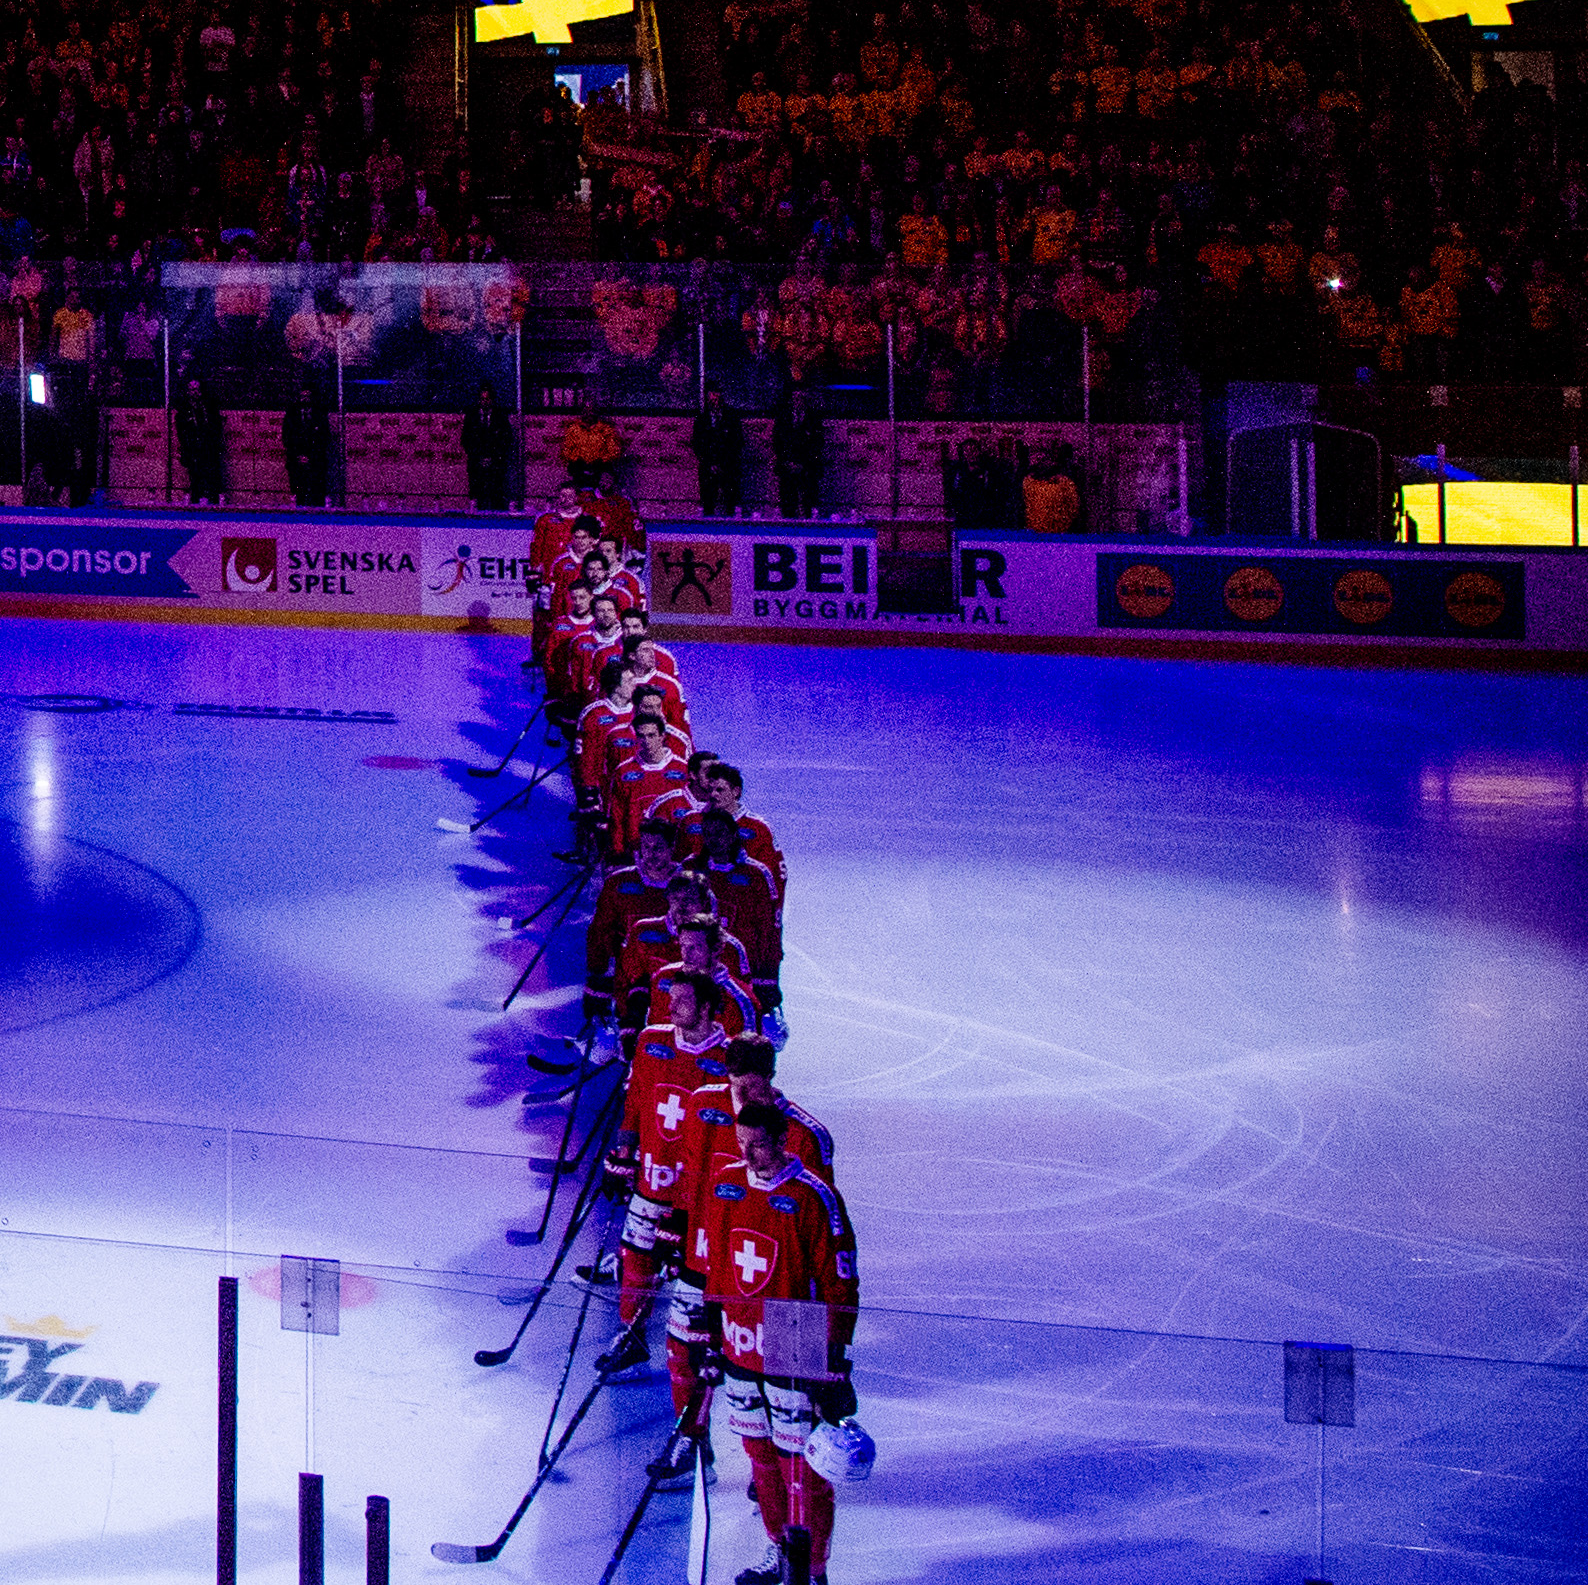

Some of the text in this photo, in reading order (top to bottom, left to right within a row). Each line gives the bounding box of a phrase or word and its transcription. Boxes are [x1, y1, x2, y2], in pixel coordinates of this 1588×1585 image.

[288, 550, 417, 573] SVENSKA
[753, 543, 1008, 598] BEIR
[288, 574, 355, 596] SPEL
[753, 598, 1008, 625] BYGGMIAL
